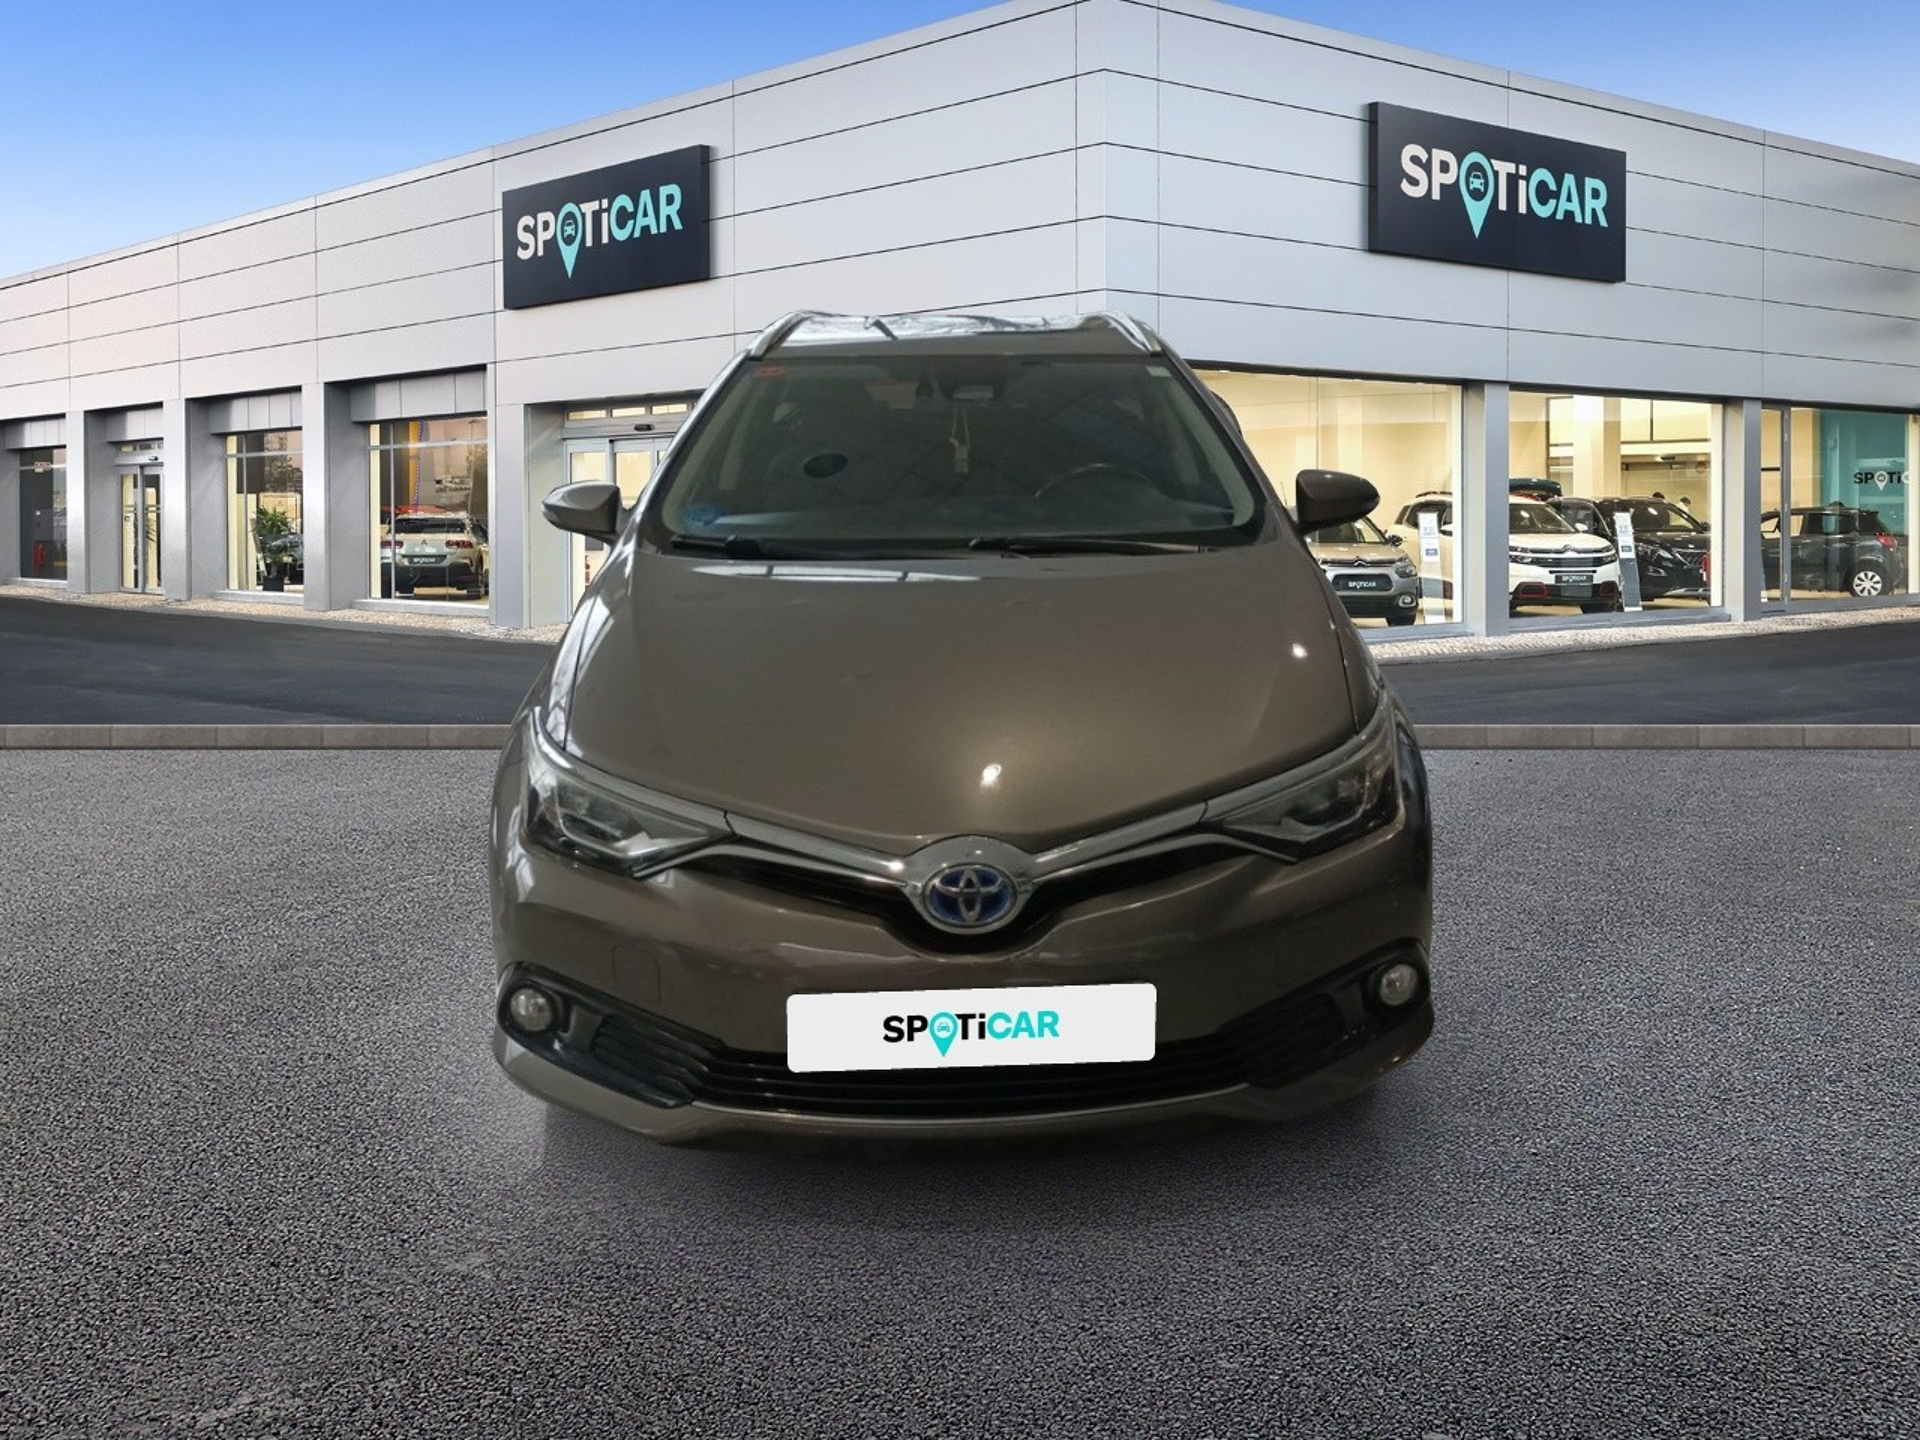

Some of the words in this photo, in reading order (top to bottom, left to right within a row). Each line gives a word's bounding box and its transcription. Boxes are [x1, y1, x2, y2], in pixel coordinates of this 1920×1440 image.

[516, 183, 683, 278] SPOTiCAR
[1400, 143, 1609, 239] SPOTiCAR
[882, 1010, 1060, 1057] SPOTiCAR
